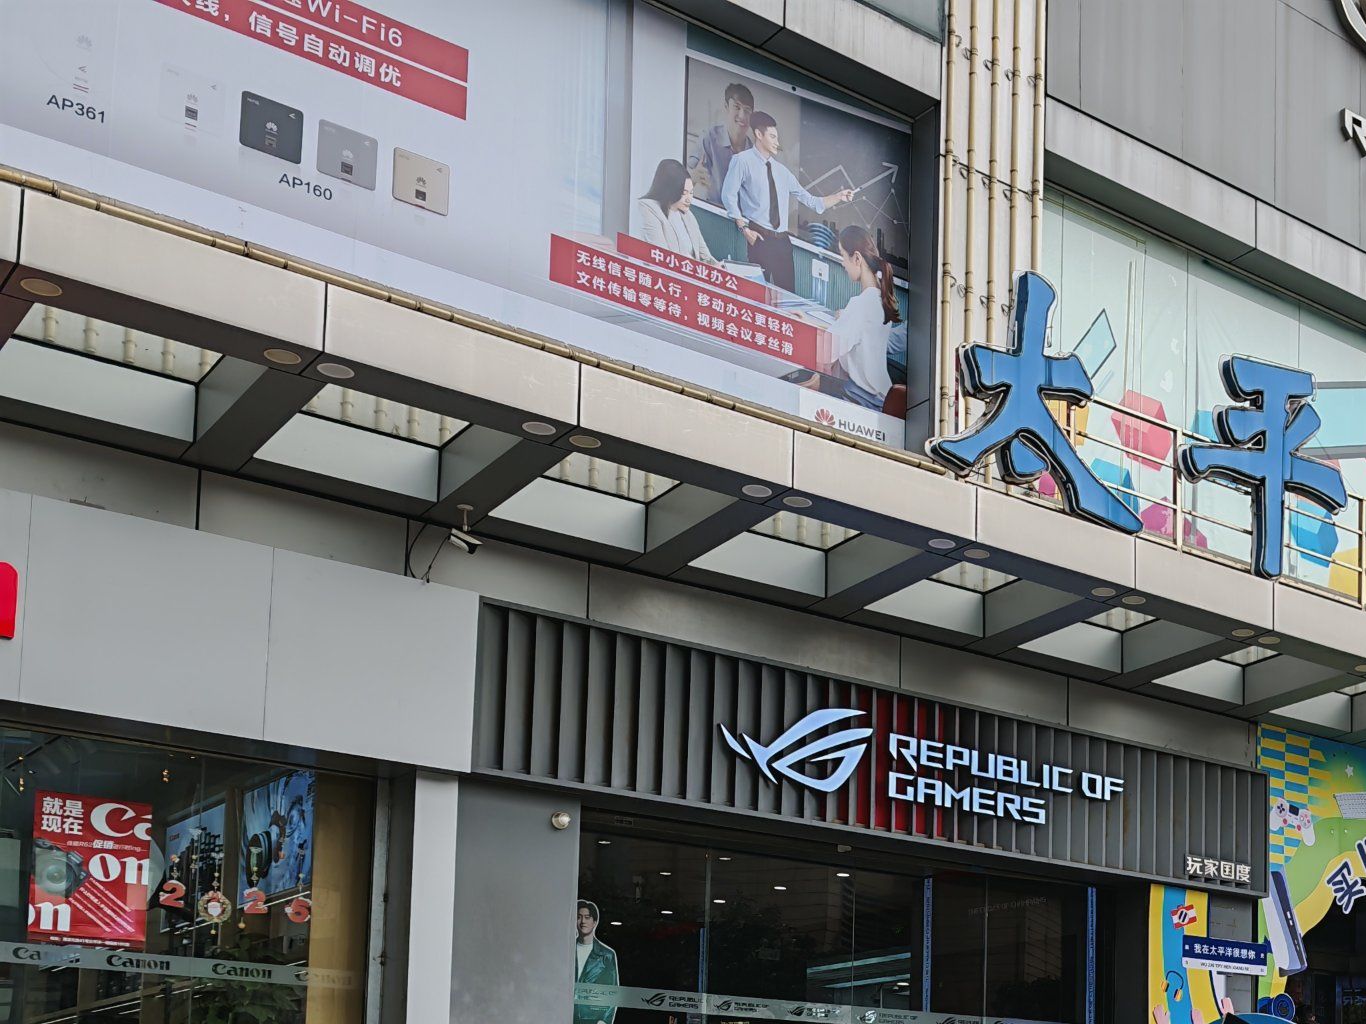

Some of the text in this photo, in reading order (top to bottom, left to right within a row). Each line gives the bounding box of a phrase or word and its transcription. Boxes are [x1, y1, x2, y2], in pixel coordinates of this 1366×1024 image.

[290, 0, 404, 47] Wi-Fi6
[181, 0, 402, 87] 线，信号自动调优
[46, 94, 106, 124] AP361
[278, 173, 333, 200] AP160
[650, 248, 739, 291] 中小企业办公
[837, 418, 886, 443] HUAWEI
[888, 732, 1125, 802] REPUBLIC OF
[42, 796, 84, 818] 就是
[888, 770, 1047, 825] GAMERS
[41, 814, 84, 835] 现在
[1186, 856, 1252, 883] 玩家国度
[106, 953, 171, 972] Canon
[1193, 943, 1256, 960] 我在太平洋很想你
[211, 962, 273, 980] Canon
